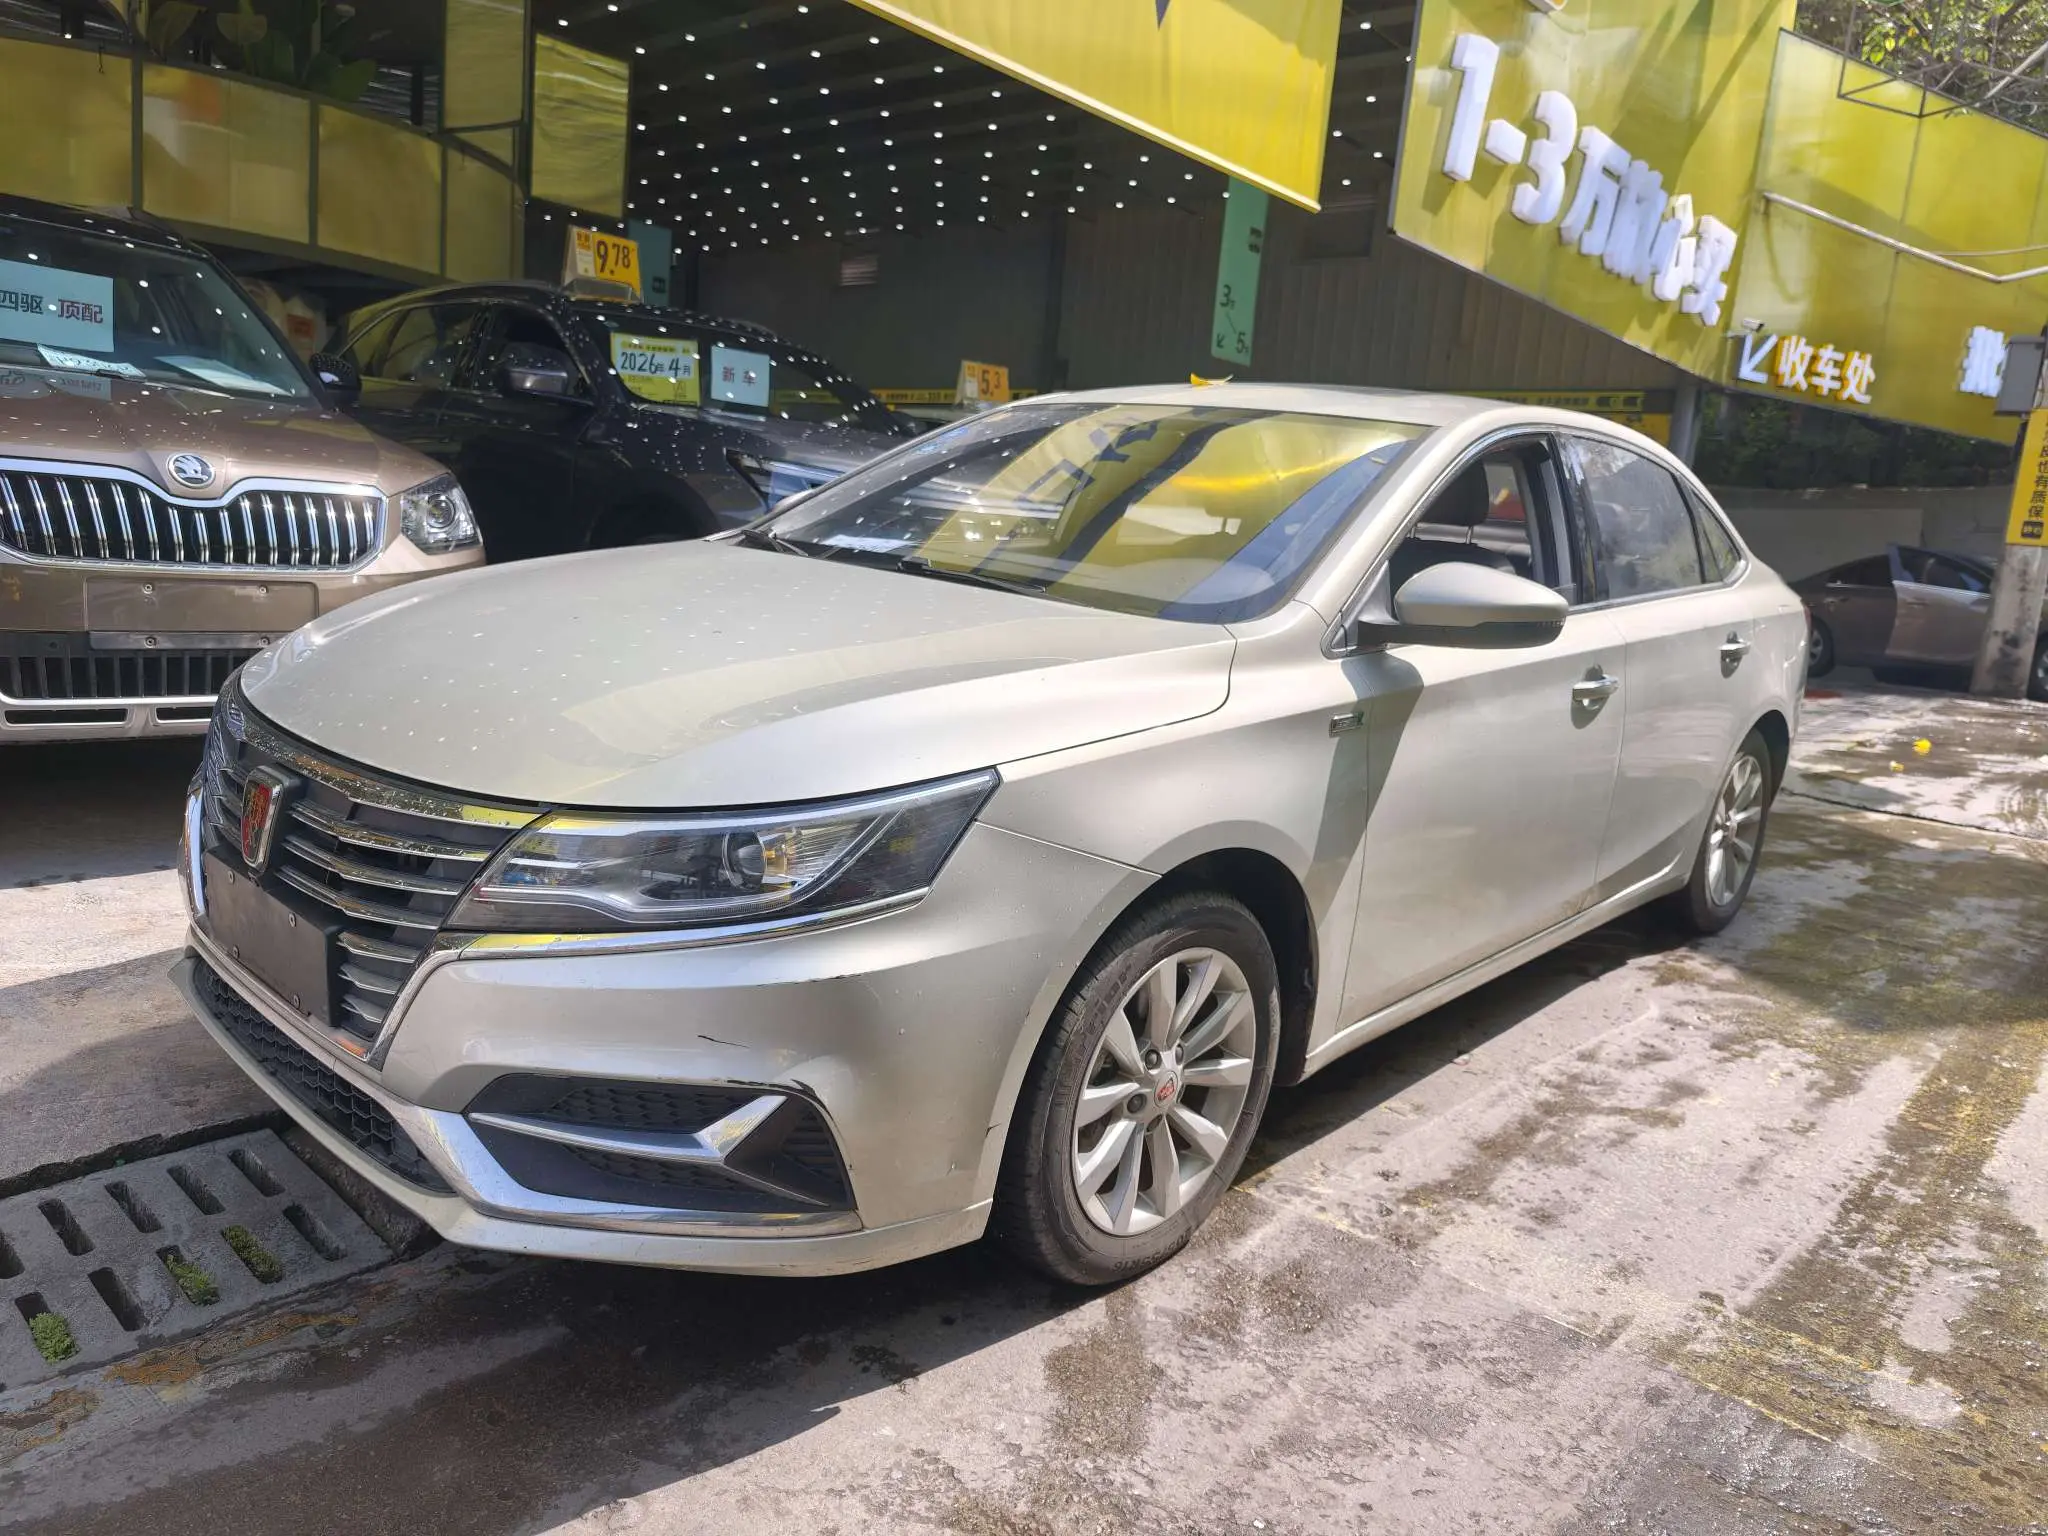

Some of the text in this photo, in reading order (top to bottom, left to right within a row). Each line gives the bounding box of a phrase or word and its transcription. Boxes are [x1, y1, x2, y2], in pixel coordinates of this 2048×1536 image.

[0, 289, 104, 324] 四驱 顶配
[1775, 334, 1876, 404] 收车处
